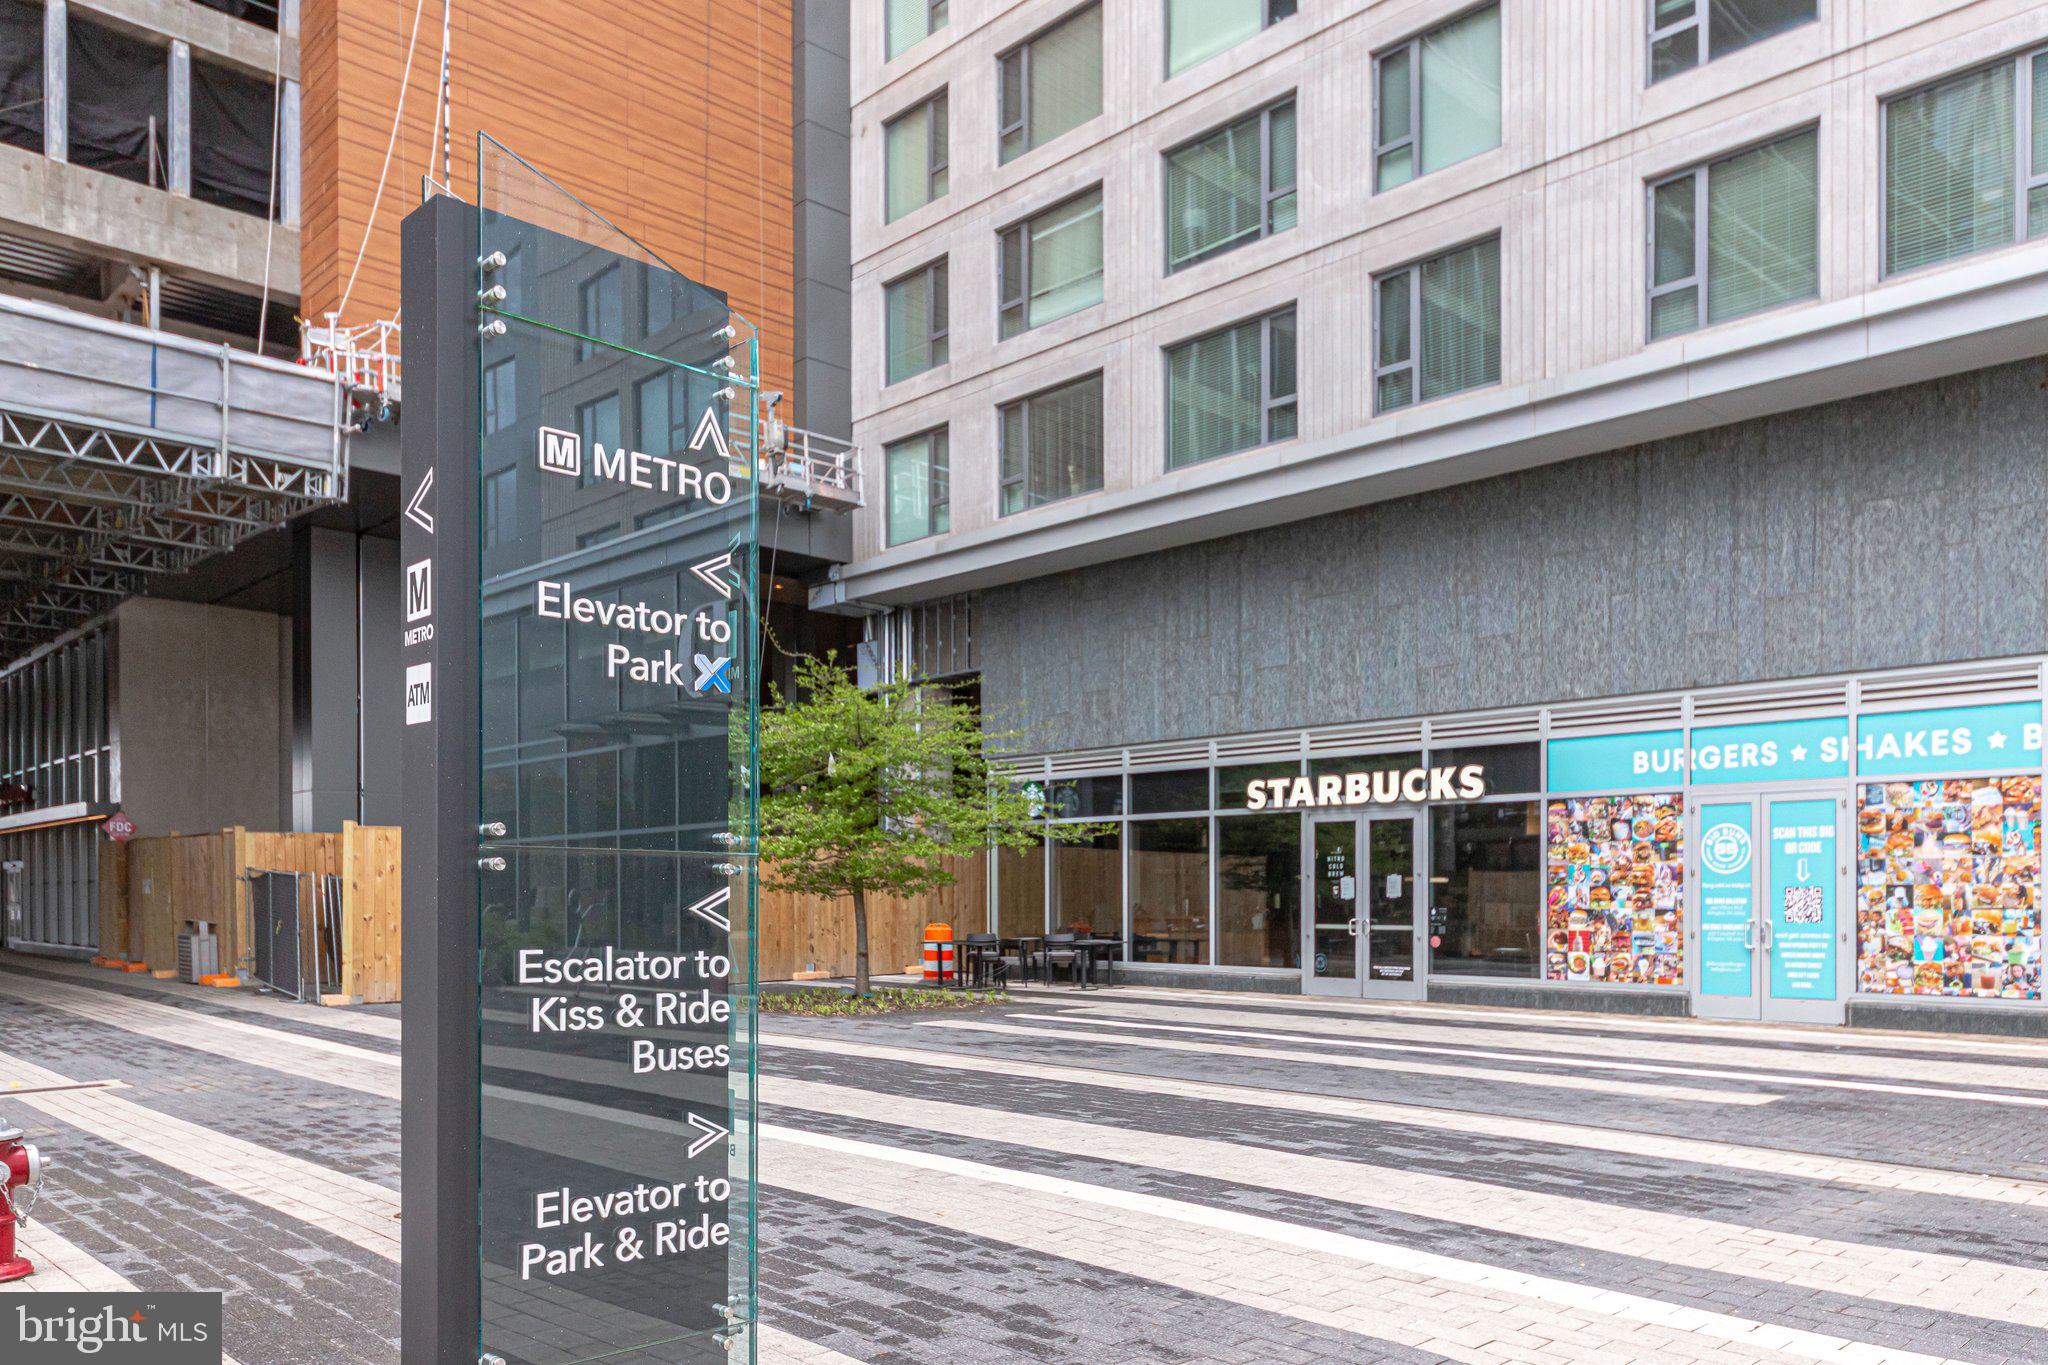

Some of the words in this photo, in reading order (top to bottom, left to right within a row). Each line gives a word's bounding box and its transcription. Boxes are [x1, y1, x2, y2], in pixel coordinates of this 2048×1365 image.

[594, 442, 731, 505] METRO
[409, 567, 428, 615] M
[538, 580, 688, 637] Elevator
[695, 612, 731, 643] to
[404, 623, 434, 647] METRO
[608, 643, 684, 687] Park
[407, 681, 430, 708] ATM
[1633, 740, 1779, 775] BURGERS
[1819, 727, 1972, 763] SHAKES
[1246, 764, 1486, 811] STARBUCKS
[109, 821, 132, 833] FDC
[1773, 826, 1796, 840] SCAN
[1797, 825, 1818, 839] THIS
[1818, 824, 1834, 838] BIG
[1784, 841, 1797, 854] QR
[1798, 840, 1822, 854] CODE
[518, 946, 686, 985] Escalator
[695, 949, 731, 980] to
[531, 996, 604, 1033] Kiss
[616, 993, 645, 1028] &
[656, 989, 730, 1026] Ride
[633, 1039, 730, 1075] Buses
[536, 1180, 686, 1229] Elevator
[694, 1175, 731, 1203] to
[520, 1231, 605, 1281] Park
[615, 1226, 645, 1262] &
[656, 1213, 730, 1257] Ride
